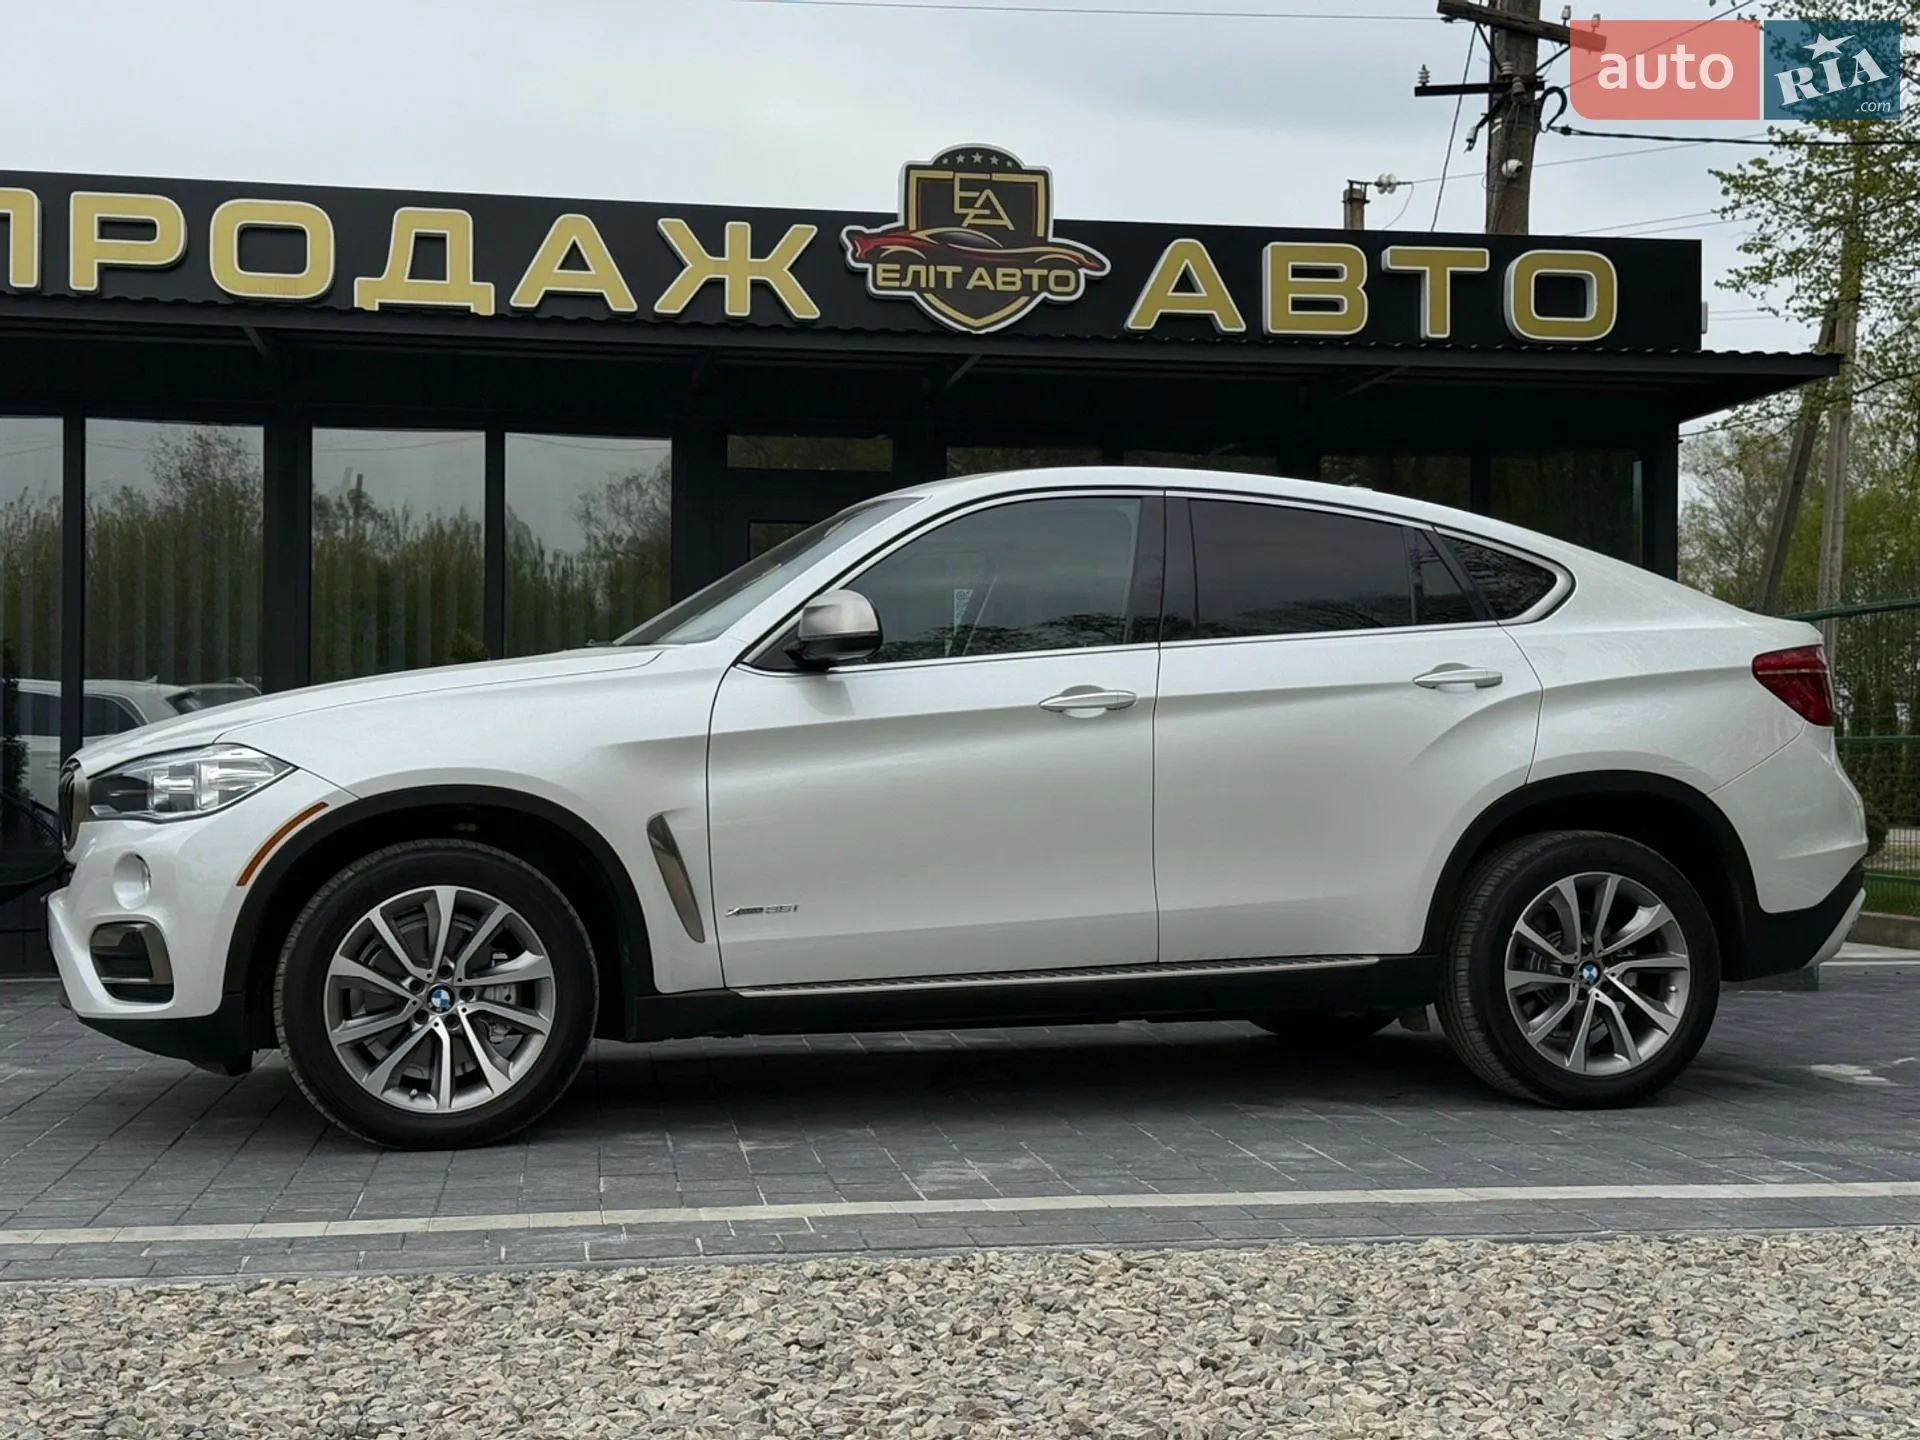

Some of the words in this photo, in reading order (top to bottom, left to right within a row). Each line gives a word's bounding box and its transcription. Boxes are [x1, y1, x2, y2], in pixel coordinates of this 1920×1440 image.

[876, 263, 963, 289] ЕЛІТ
[966, 266, 1077, 293] АВТО
[1126, 238, 1619, 342] АВТО
